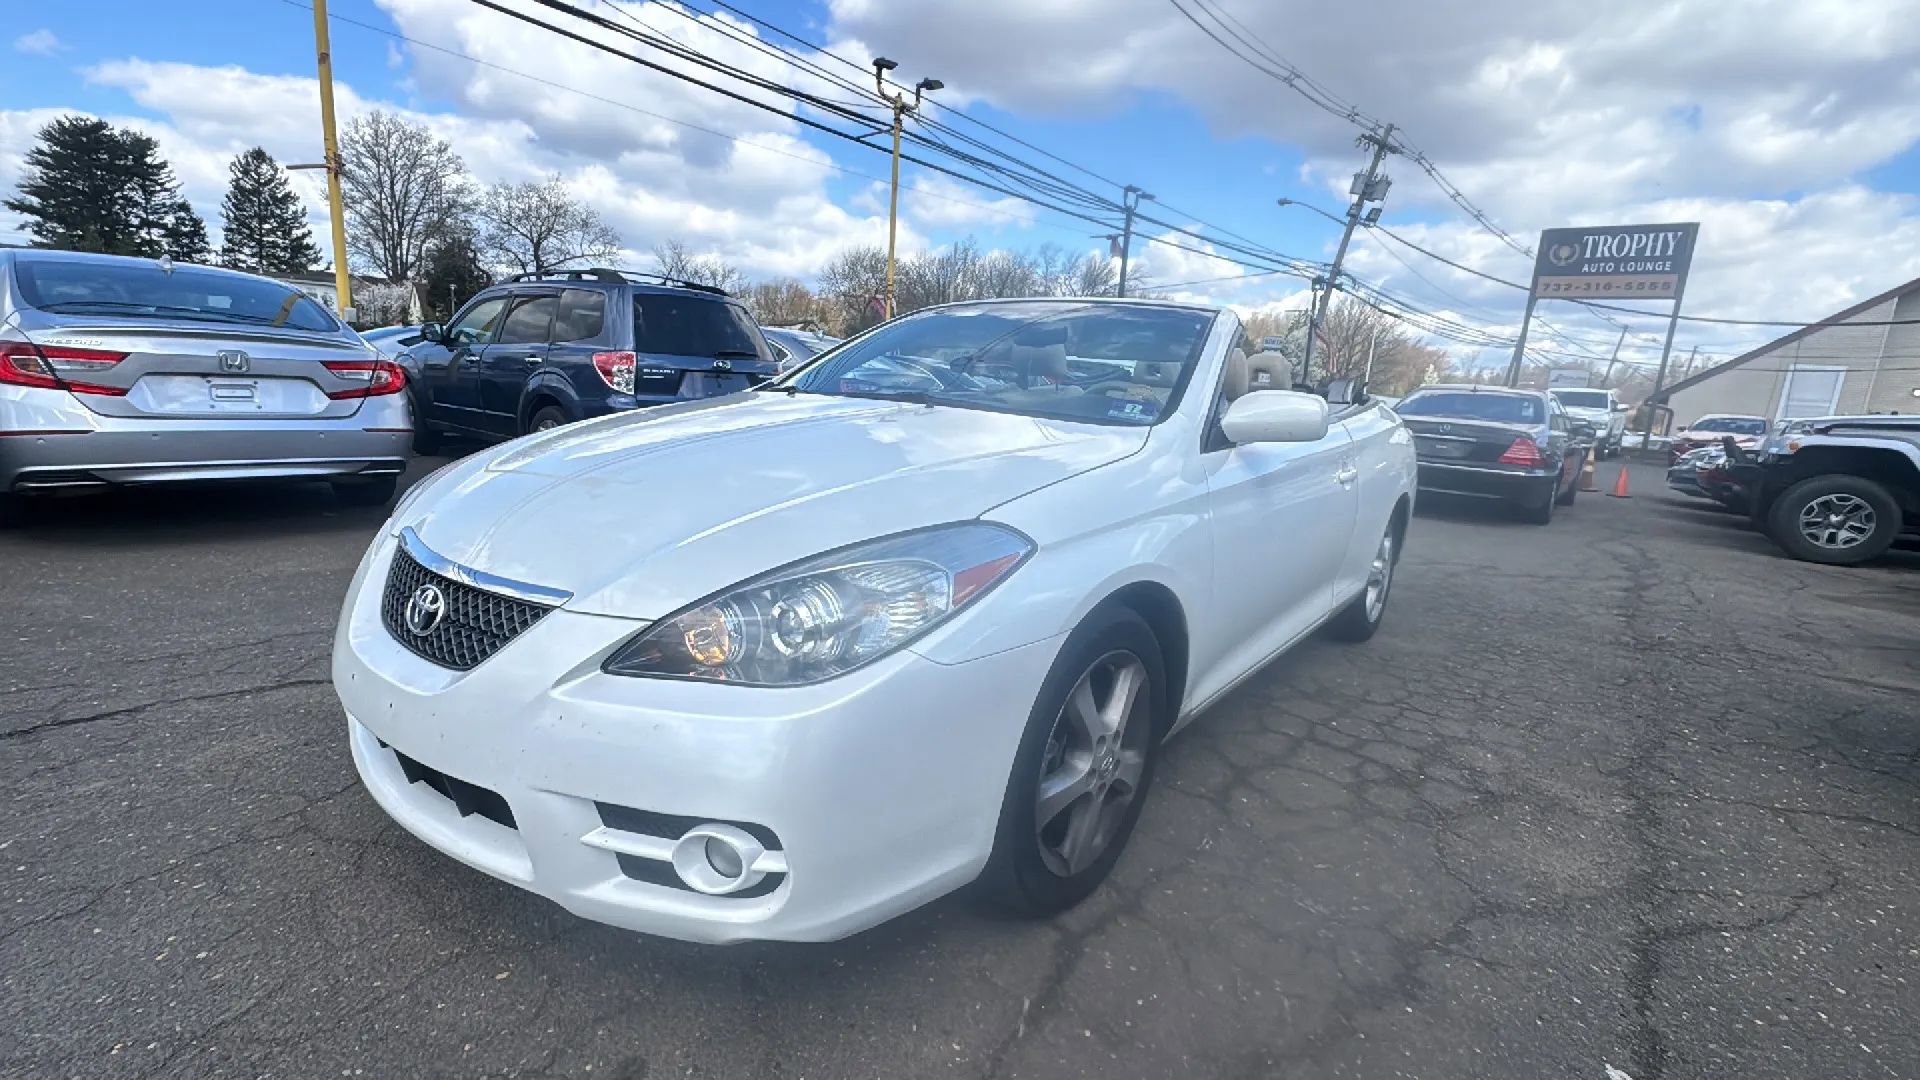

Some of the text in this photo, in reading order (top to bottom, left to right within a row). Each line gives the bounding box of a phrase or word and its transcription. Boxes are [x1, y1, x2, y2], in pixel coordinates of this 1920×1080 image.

[1582, 231, 1683, 259] TROPHY
[1582, 261, 1673, 273] AUTO LOUNGE
